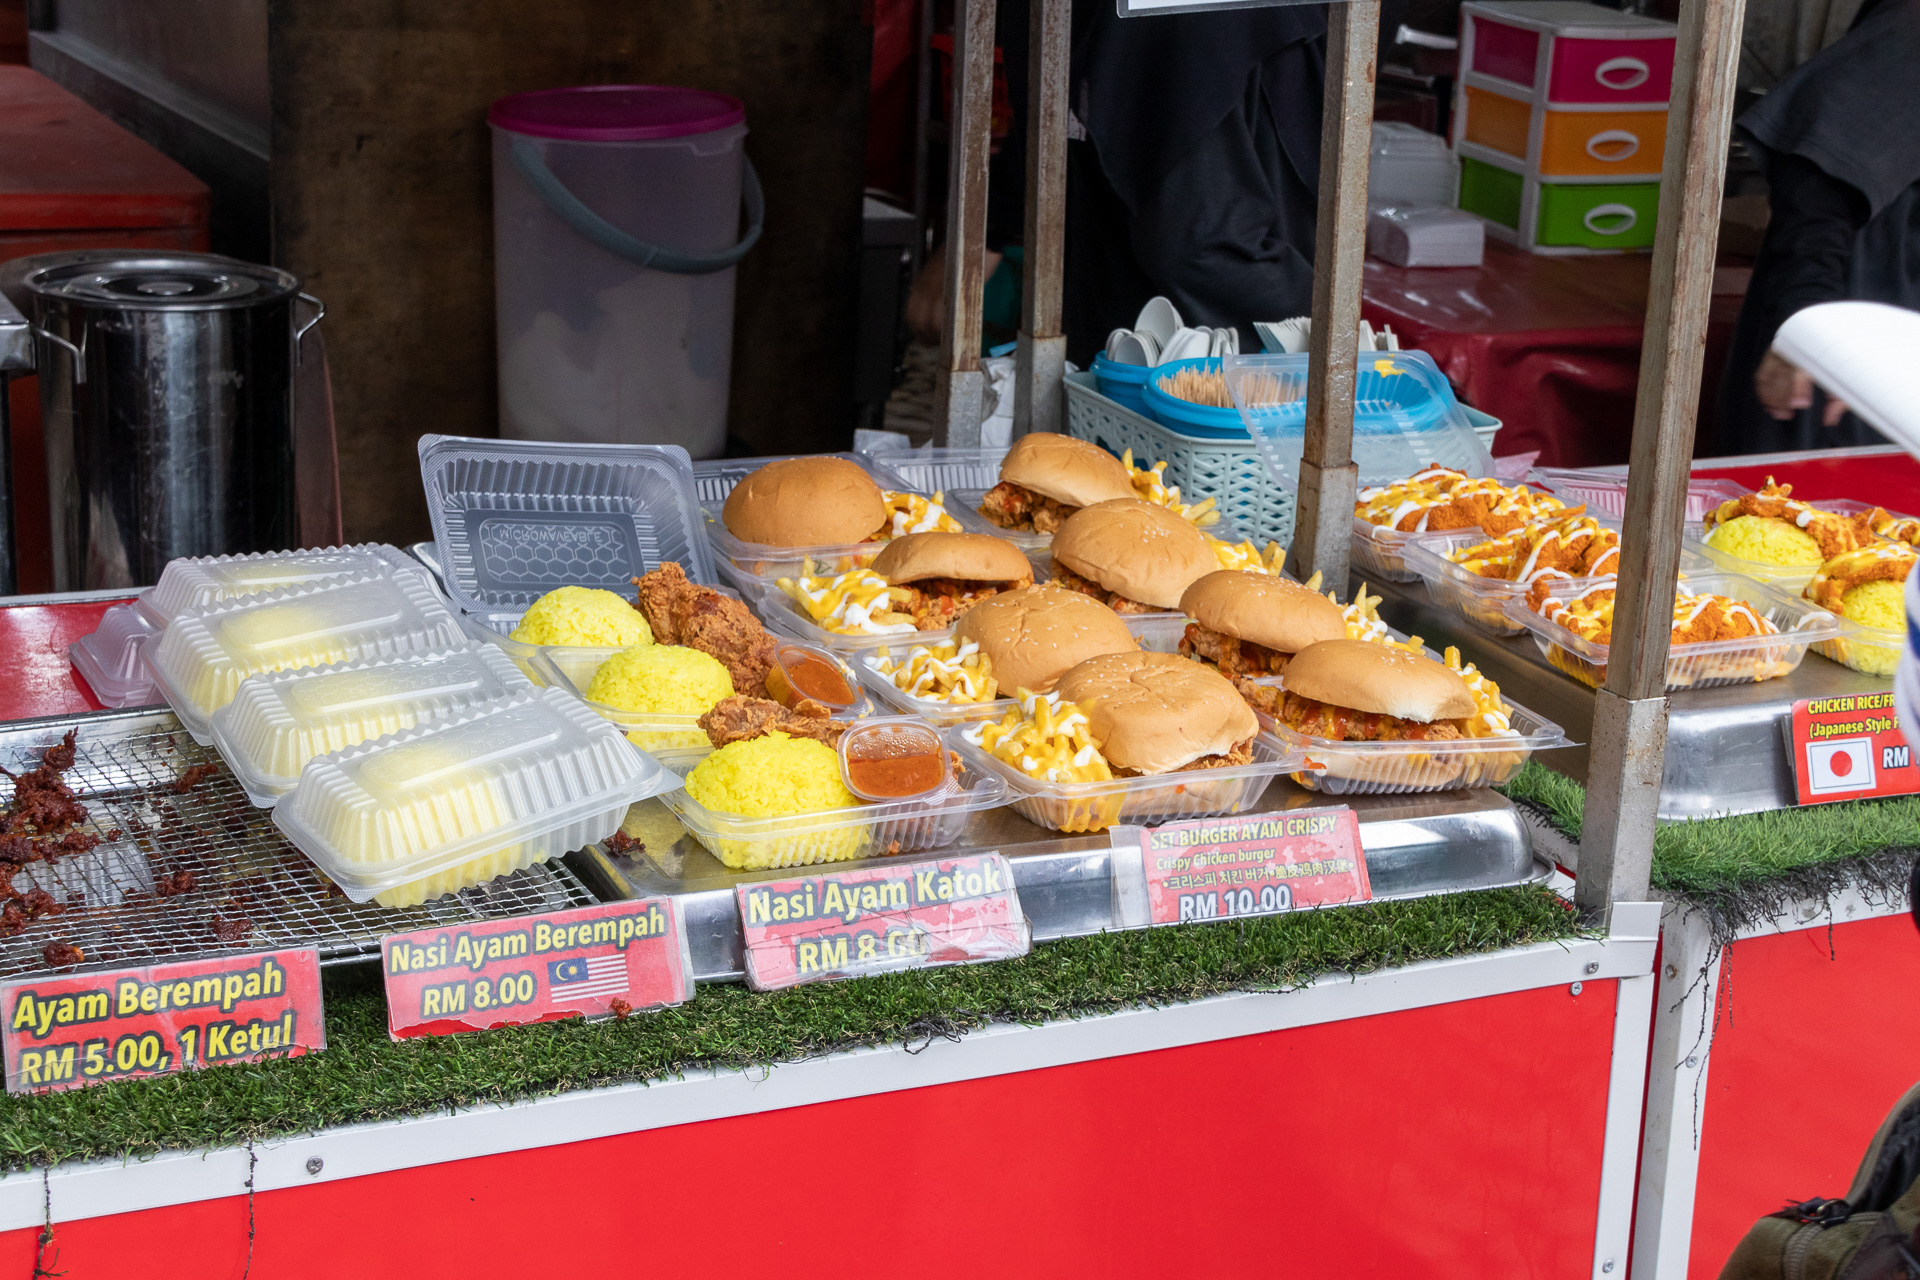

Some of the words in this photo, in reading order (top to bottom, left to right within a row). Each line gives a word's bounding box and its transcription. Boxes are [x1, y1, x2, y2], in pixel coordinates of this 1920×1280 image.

[1807, 697, 1855, 714] CHICKEN
[1857, 693, 1895, 710] RICE/FR
[1809, 721, 1864, 739] (Japanese
[1865, 716, 1891, 735] Style
[1882, 746, 1909, 769] RM
[1150, 831, 1176, 850] SET
[1179, 825, 1237, 847] BURGER
[1239, 820, 1283, 841] AYAM
[1286, 815, 1337, 837] CRISPY
[1156, 854, 1191, 872] Crispy
[1193, 850, 1236, 868] Chicken
[1238, 847, 1276, 865] burger
[748, 884, 814, 924] Nasi
[822, 880, 908, 921] Ayam
[916, 862, 1000, 903] Katok
[1169, 871, 1217, 890] 크리스피
[1220, 868, 1244, 886] 치킨
[1179, 894, 1217, 920] RM
[1223, 885, 1291, 915] 10.00
[391, 937, 446, 973] Nasi
[454, 932, 527, 970] Ayam
[534, 906, 665, 952] Berempah
[798, 937, 848, 974] RM
[857, 927, 926, 960] 800
[13, 992, 108, 1037] Ayam
[117, 961, 283, 1015] Berempah
[423, 984, 466, 1017] RM
[473, 973, 534, 1009] 8.00
[20, 1046, 75, 1085] RM
[84, 1034, 170, 1077] 5.00,
[180, 1029, 198, 1062] 1
[208, 1013, 293, 1058] Ketul
